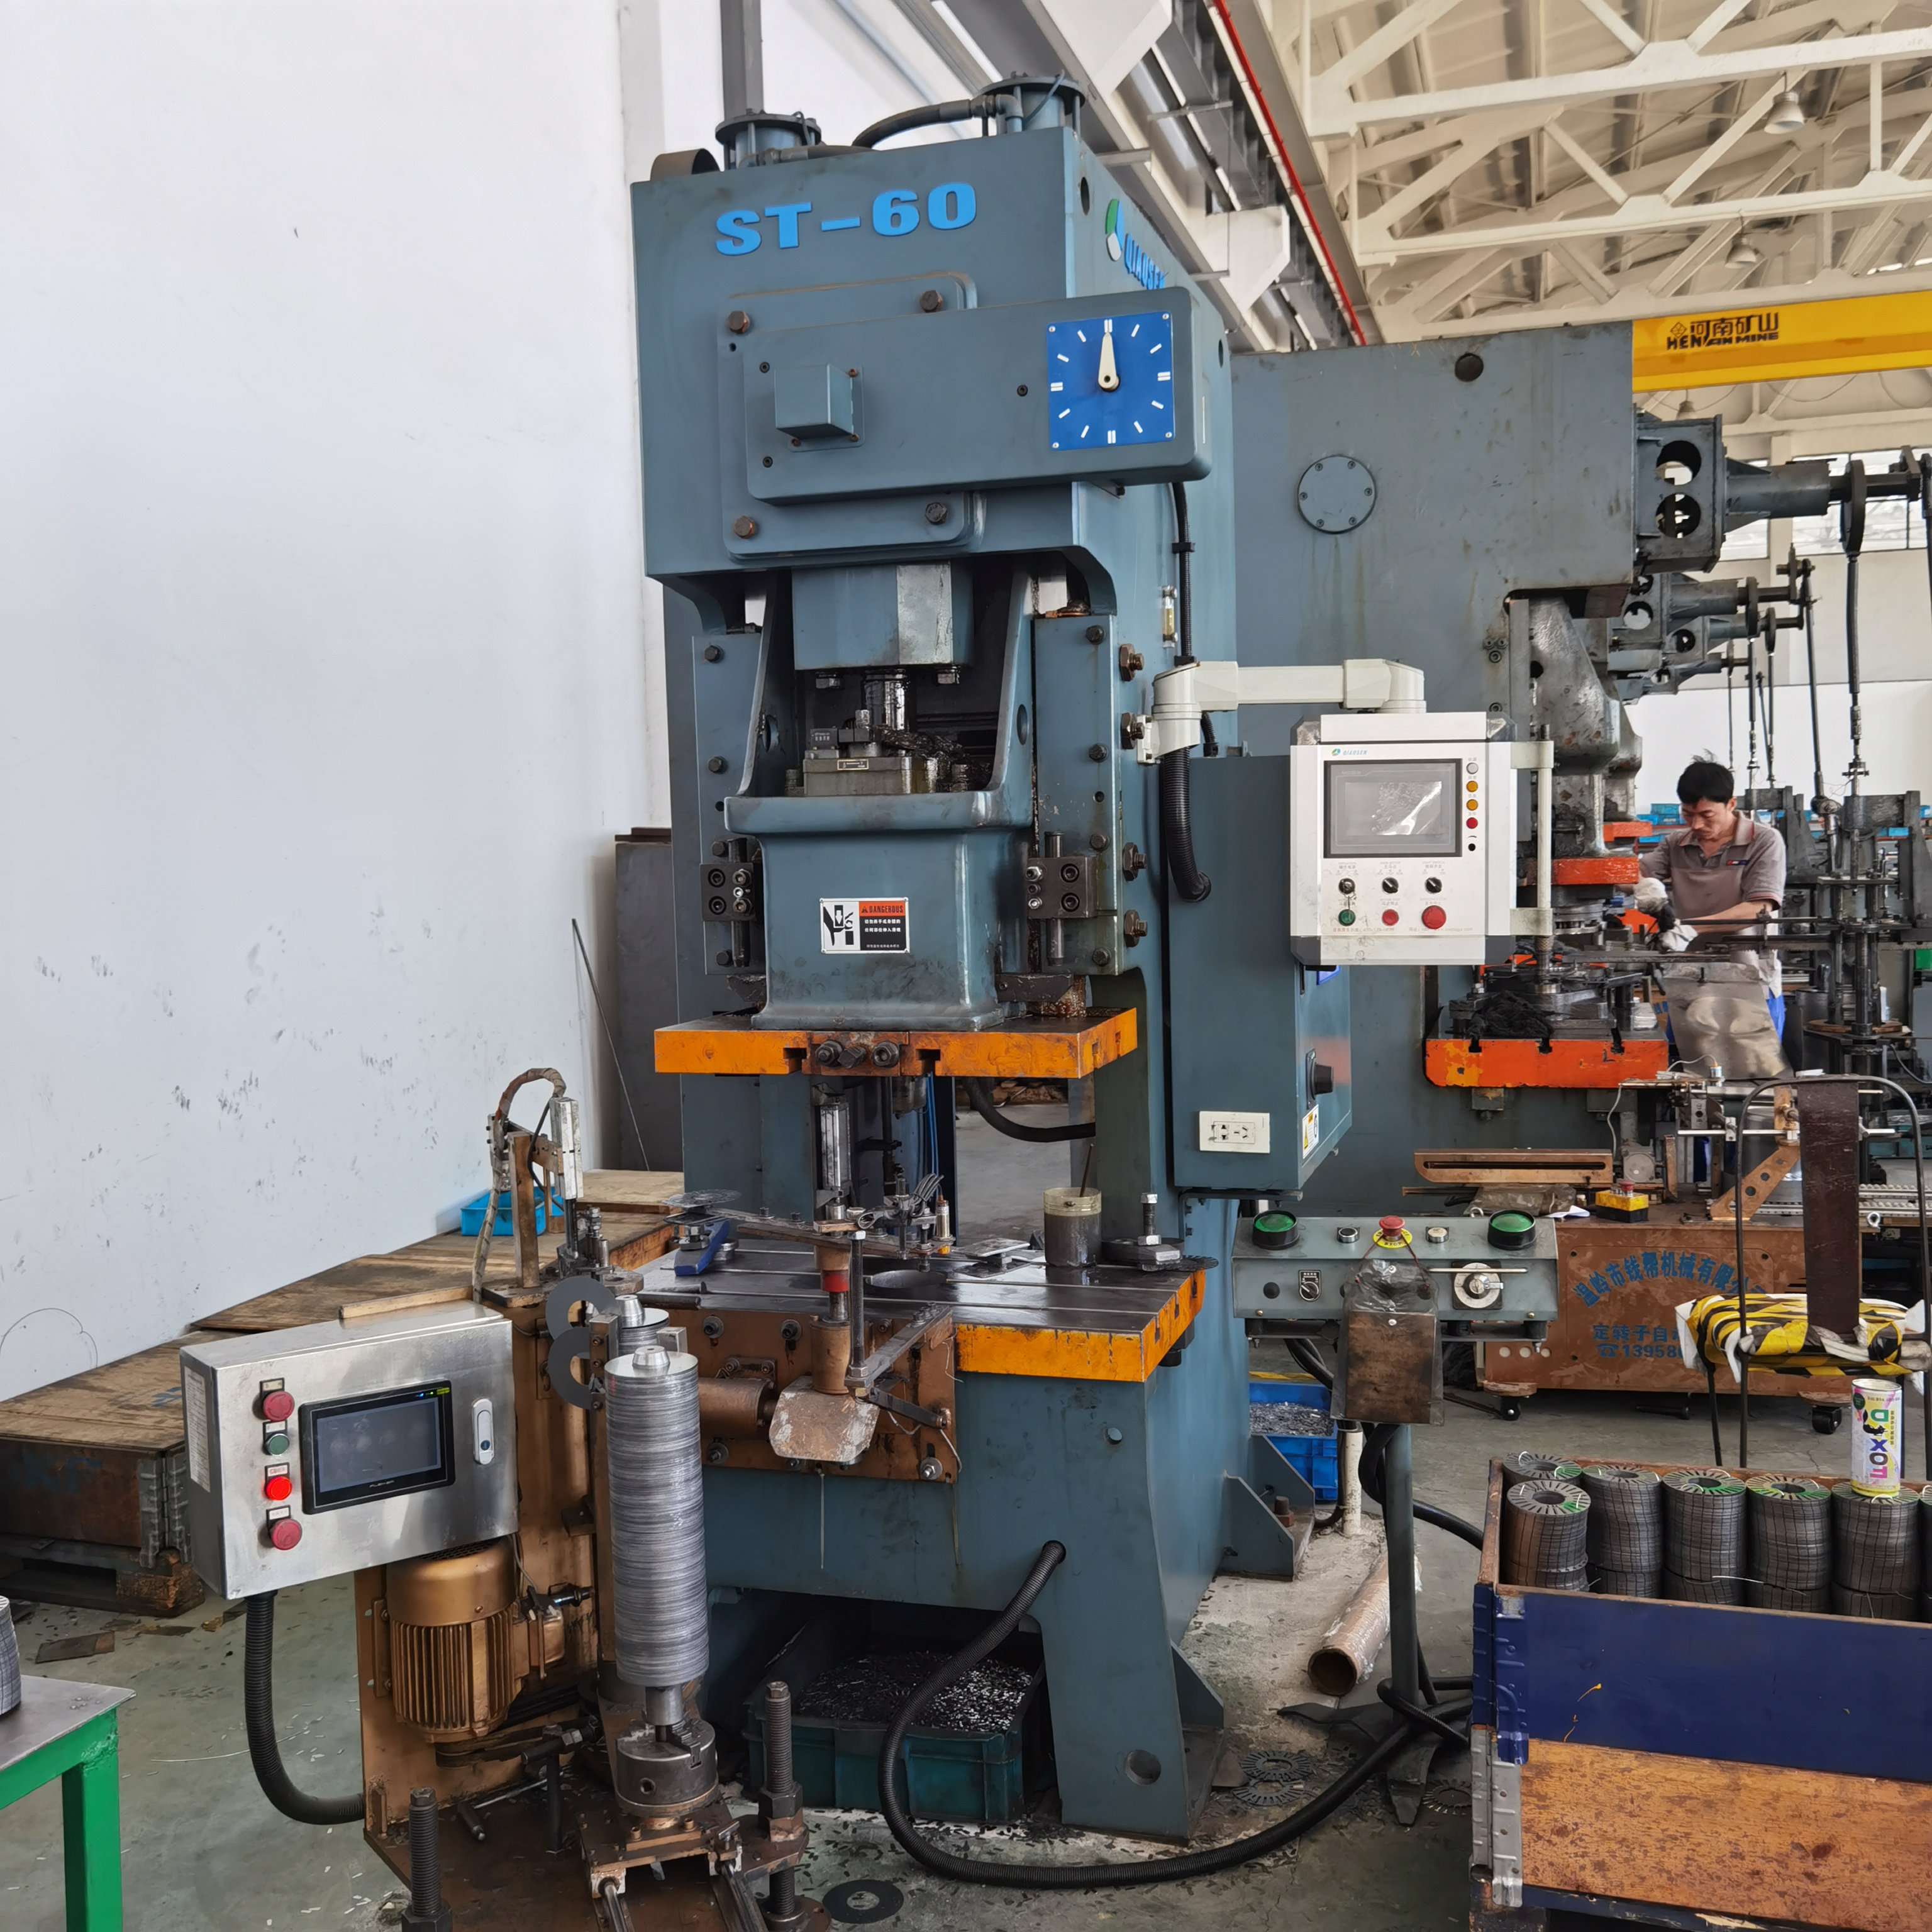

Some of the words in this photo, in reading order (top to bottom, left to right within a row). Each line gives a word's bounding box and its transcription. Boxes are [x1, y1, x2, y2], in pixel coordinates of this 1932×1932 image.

[1690, 313, 1779, 338] 河南矿山
[1735, 332, 1779, 343] MINE
[869, 905, 904, 913] DANGEROUS
